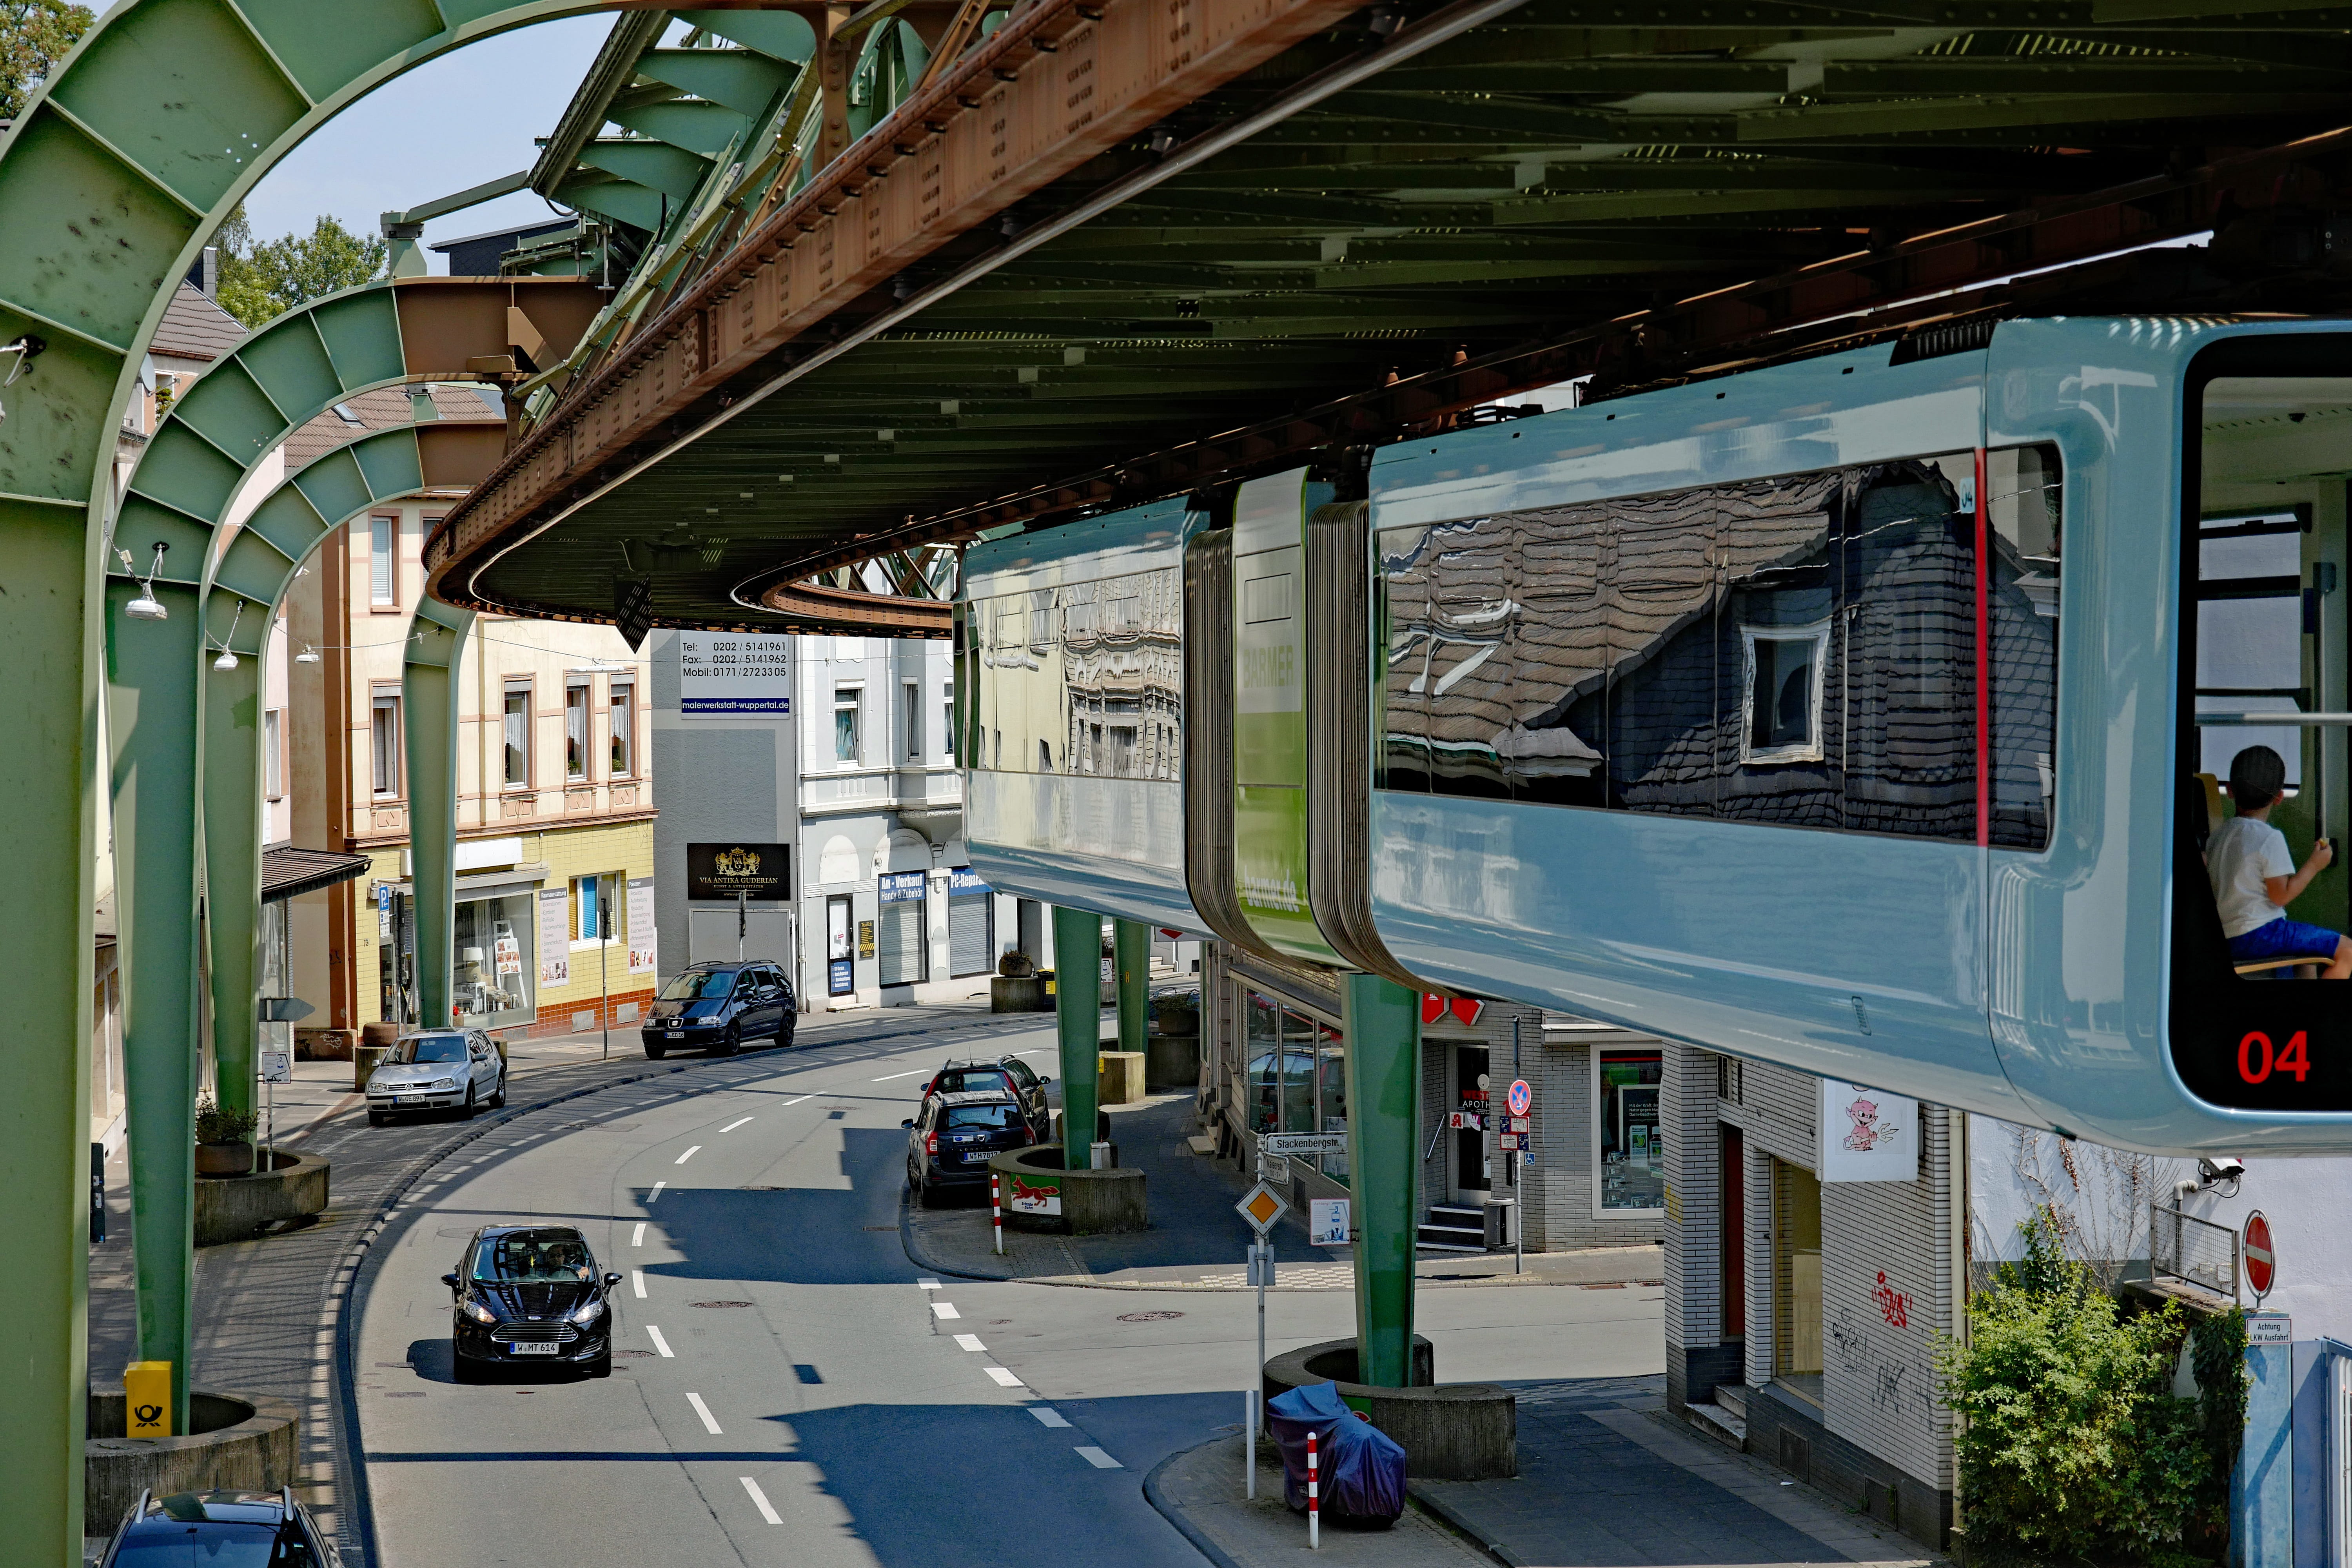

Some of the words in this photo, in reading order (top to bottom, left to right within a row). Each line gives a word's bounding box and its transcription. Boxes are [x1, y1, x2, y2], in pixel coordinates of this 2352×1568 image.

[683, 642, 698, 651] Tel:
[713, 642, 736, 651] 0202
[746, 642, 785, 651] 5141961
[683, 655, 701, 664] Fax:
[713, 655, 736, 663] 0202
[745, 655, 786, 663] 5141962
[1243, 645, 1293, 688] BARMER
[683, 668, 711, 677] Mobil:
[682, 701, 789, 710] malerwerkstatt-wuppertal.de
[881, 877, 890, 889] An
[895, 874, 922, 888] Verkauf
[881, 890, 897, 902] Handy
[898, 890, 902, 898] &
[902, 887, 922, 898] Zubehör
[2238, 1031, 2311, 1084] 04
[1277, 1138, 1339, 1149] Stackenbergstr.
[2258, 1323, 2280, 1332] Achtung
